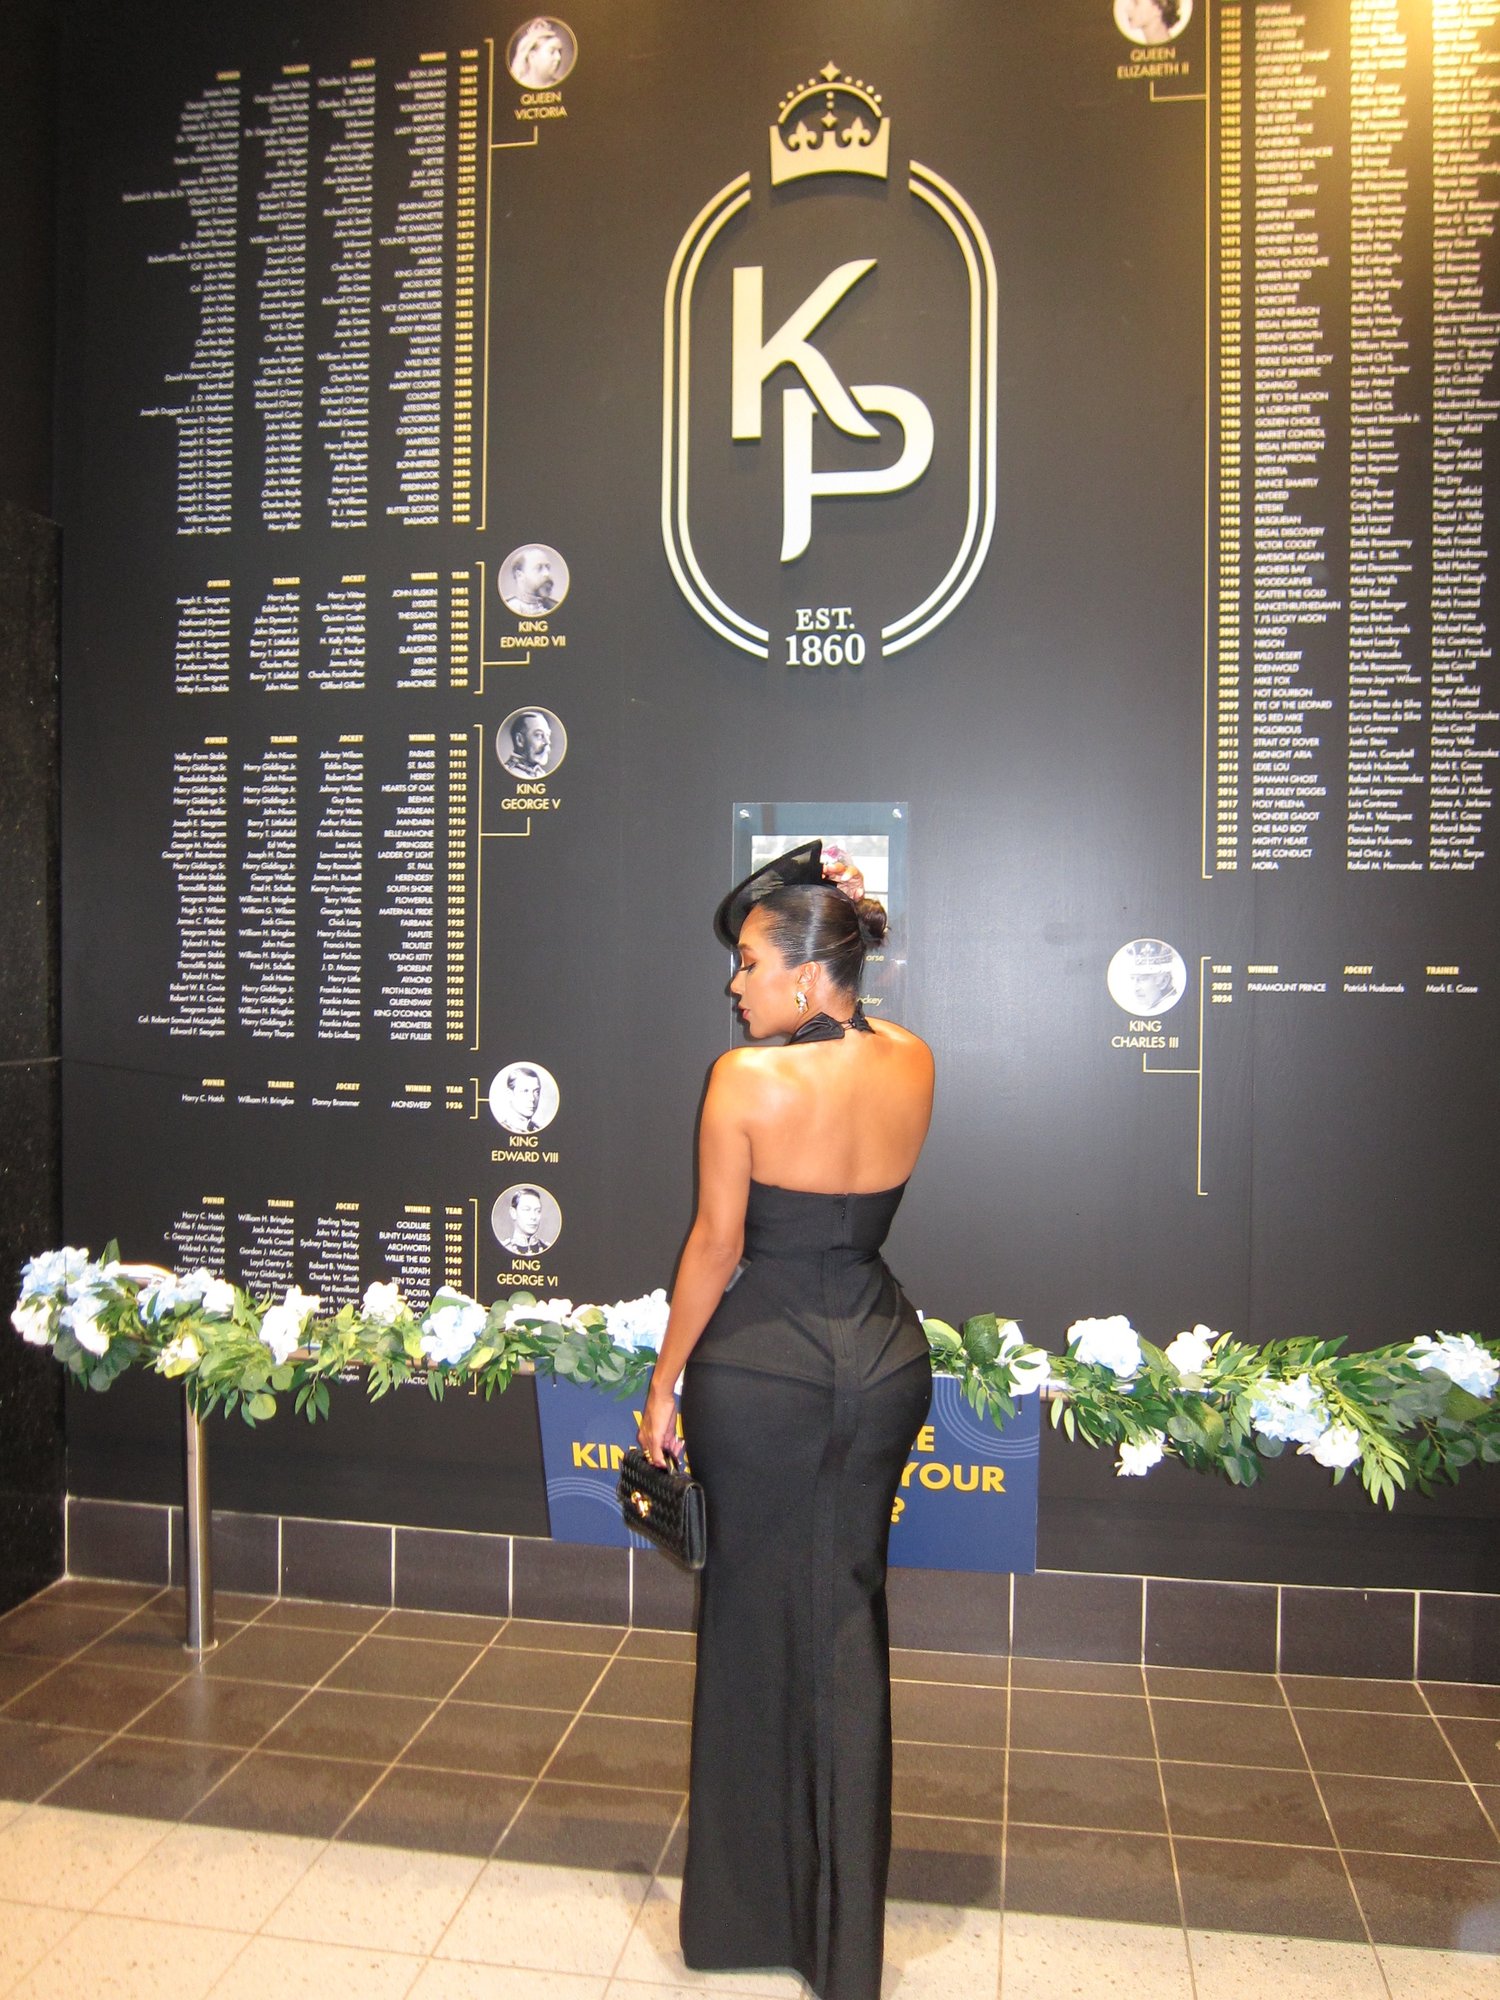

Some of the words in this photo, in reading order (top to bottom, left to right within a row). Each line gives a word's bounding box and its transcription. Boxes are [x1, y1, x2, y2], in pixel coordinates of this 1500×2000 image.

[1130, 48, 1175, 62] QUEEN
[1117, 61, 1179, 78] ELIZABETH
[1181, 62, 1189, 74] II
[521, 91, 561, 105] QUEEN
[515, 104, 567, 119] VICTORIA
[452, 571, 469, 579] YEAR
[795, 607, 855, 632] EST.
[519, 621, 548, 632] KING
[501, 636, 549, 648] EDWARD
[551, 636, 566, 646] VII
[785, 634, 866, 666] 1860
[382, 784, 407, 792] HEARTS
[407, 784, 417, 792] OF
[418, 784, 435, 792] OAK
[517, 783, 546, 794] KING
[501, 798, 549, 809] GEORGE
[552, 799, 561, 809] V
[1218, 800, 1238, 808] 2017
[1252, 800, 1274, 808] HOLY
[1274, 800, 1305, 808] HELENA
[1217, 825, 1238, 833] 2019
[1252, 824, 1270, 833] ONE
[1272, 824, 1289, 833] BAD
[1290, 824, 1307, 833] BOY
[1217, 849, 1236, 857] 2021
[1252, 849, 1271, 857] SAFE
[1272, 849, 1312, 858] CONDUCT
[411, 885, 433, 893] SHORE
[400, 919, 433, 927] FAIRBANK
[388, 953, 415, 961] YOUNG
[1212, 965, 1232, 973] YEAR
[1344, 966, 1373, 974] JOCKEY
[1426, 966, 1459, 974] TRAINER
[1212, 982, 1232, 990] 2023
[1248, 983, 1298, 992] PARAMOUNT
[1299, 983, 1326, 992] PRINCE
[1344, 983, 1368, 992] Patrick
[1369, 984, 1405, 992] Husbands
[1426, 984, 1445, 992] Mark
[1447, 984, 1454, 993] E.
[1456, 984, 1478, 993] Casse
[1212, 995, 1232, 1003] 2024
[392, 1010, 432, 1018] O'CONNOR
[1129, 1020, 1162, 1032] KING
[391, 1032, 409, 1040] SALLY
[1111, 1036, 1165, 1048] CHARLES
[1169, 1037, 1179, 1048] III
[510, 1136, 538, 1147] KING
[492, 1150, 539, 1162] EDWARD
[542, 1152, 558, 1163] VIII
[405, 1206, 431, 1214] WINNER
[445, 1207, 462, 1215] YEAR
[182, 1212, 199, 1221] Harry
[200, 1212, 206, 1220] C.
[208, 1212, 225, 1220] Hatch
[318, 1217, 340, 1228] Sterling
[341, 1219, 359, 1228] Young
[445, 1223, 462, 1231] 1937
[257, 1237, 273, 1245] Mark
[274, 1238, 294, 1246] Cowell
[402, 1233, 431, 1241] LAWLESS
[387, 1243, 431, 1252] ARCHWORTH
[385, 1254, 404, 1262] WILLIE
[406, 1255, 418, 1263] THE
[309, 1261, 328, 1269] Robert
[337, 1263, 359, 1271] Watson
[512, 1259, 541, 1271] KING
[401, 1266, 430, 1275] BUDPATH
[445, 1268, 461, 1276] 1941
[309, 1272, 331, 1281] Charles
[343, 1274, 359, 1282] Smith
[497, 1273, 544, 1286] GEORGE
[547, 1276, 558, 1286] VI
[901, 1462, 1006, 1492] YOUR
